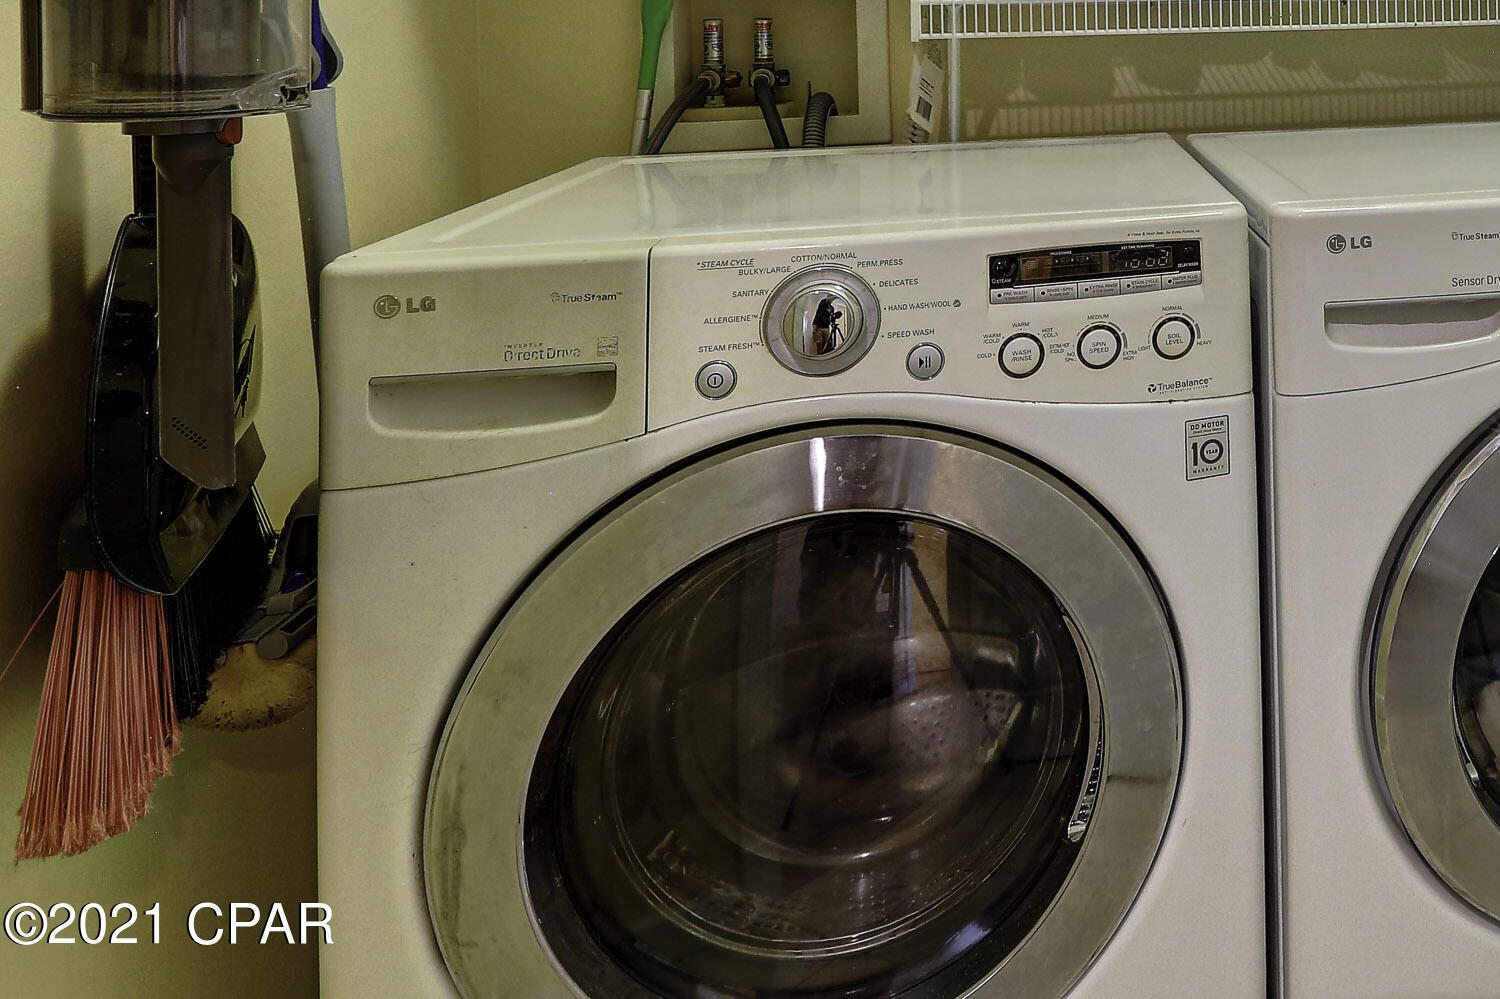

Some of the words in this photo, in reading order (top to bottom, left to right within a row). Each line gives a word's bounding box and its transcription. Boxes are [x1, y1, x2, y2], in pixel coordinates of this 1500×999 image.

[1350, 235, 1373, 250] LG
[730, 258, 755, 267] CYCLE
[790, 251, 858, 263] COTTON/NORMAL
[738, 265, 792, 276] BULKY/LARGE
[879, 278, 919, 288] DELICATES
[1451, 276, 1485, 287] Sensor
[731, 289, 769, 298] SANITARY
[407, 296, 436, 313] LG
[888, 304, 908, 312] HAND
[908, 301, 951, 311] WASH/WOOL
[887, 330, 911, 339] SPEED
[912, 328, 936, 337] WASH
[1165, 338, 1184, 346] LEVEL
[698, 343, 726, 353] STEAM
[1089, 346, 1110, 354] SPEED
[1201, 420, 1224, 429] MOTOR
[1191, 439, 1224, 466] 10
